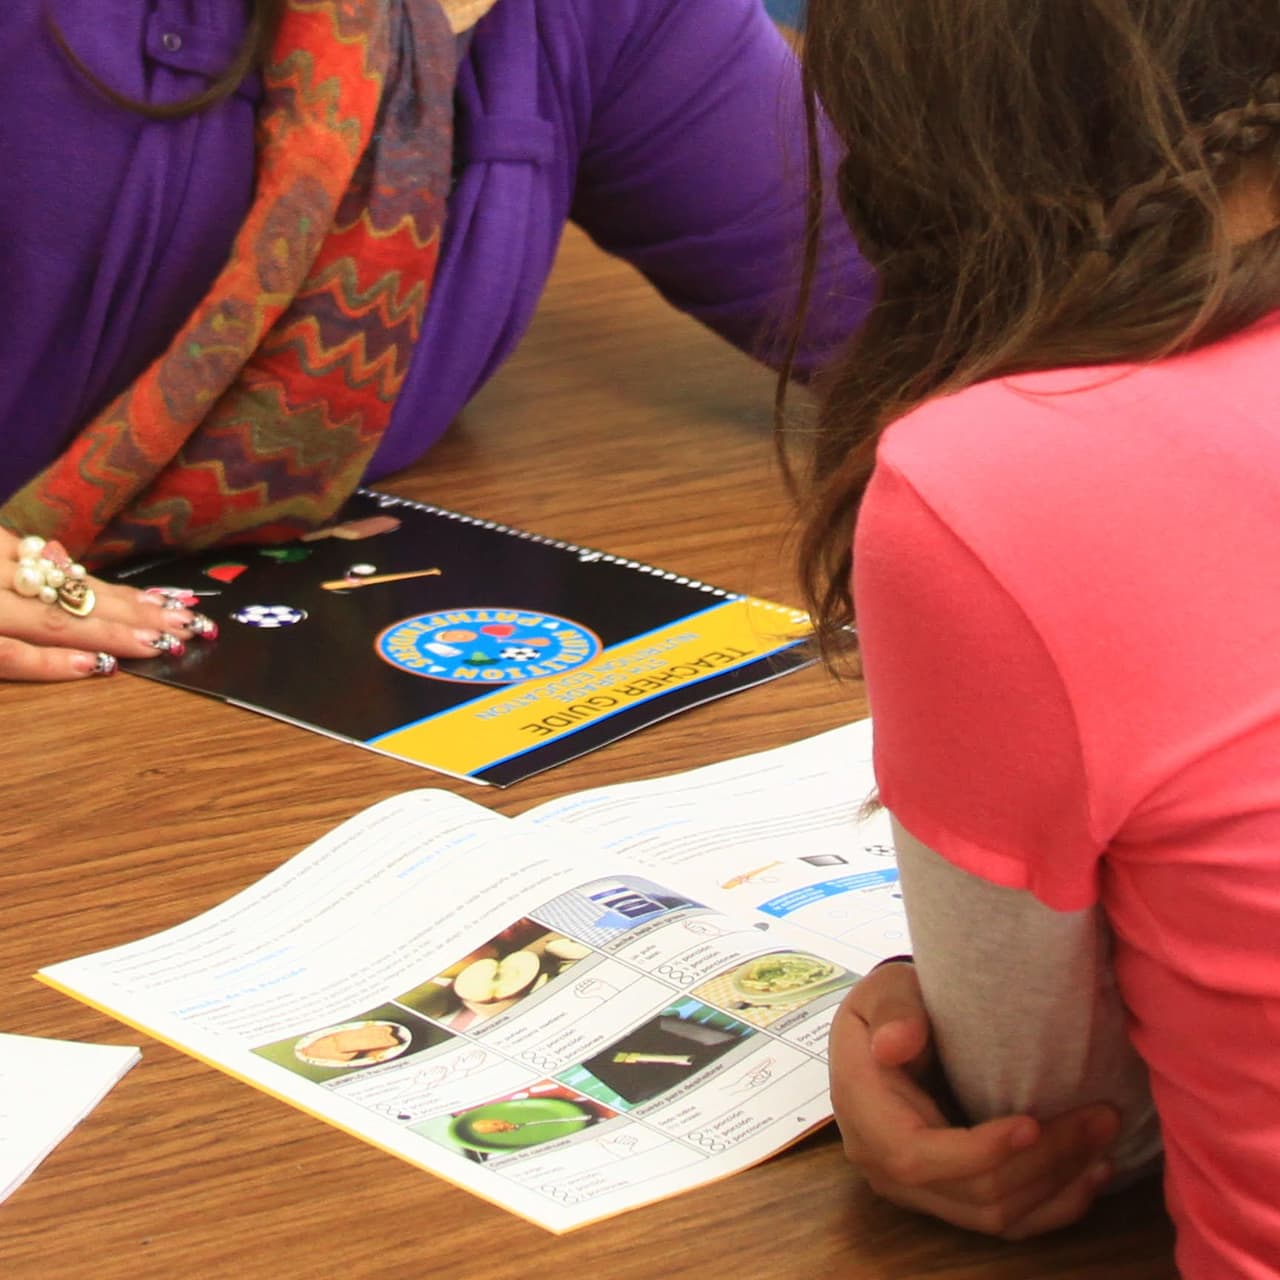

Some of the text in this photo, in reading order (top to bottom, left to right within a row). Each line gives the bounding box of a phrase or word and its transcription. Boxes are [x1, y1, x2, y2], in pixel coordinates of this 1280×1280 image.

[453, 629, 590, 680] NUTRITION
[474, 632, 701, 720] NUTRITION EDUCATION
[519, 646, 755, 737] TEACHER GUIDE
